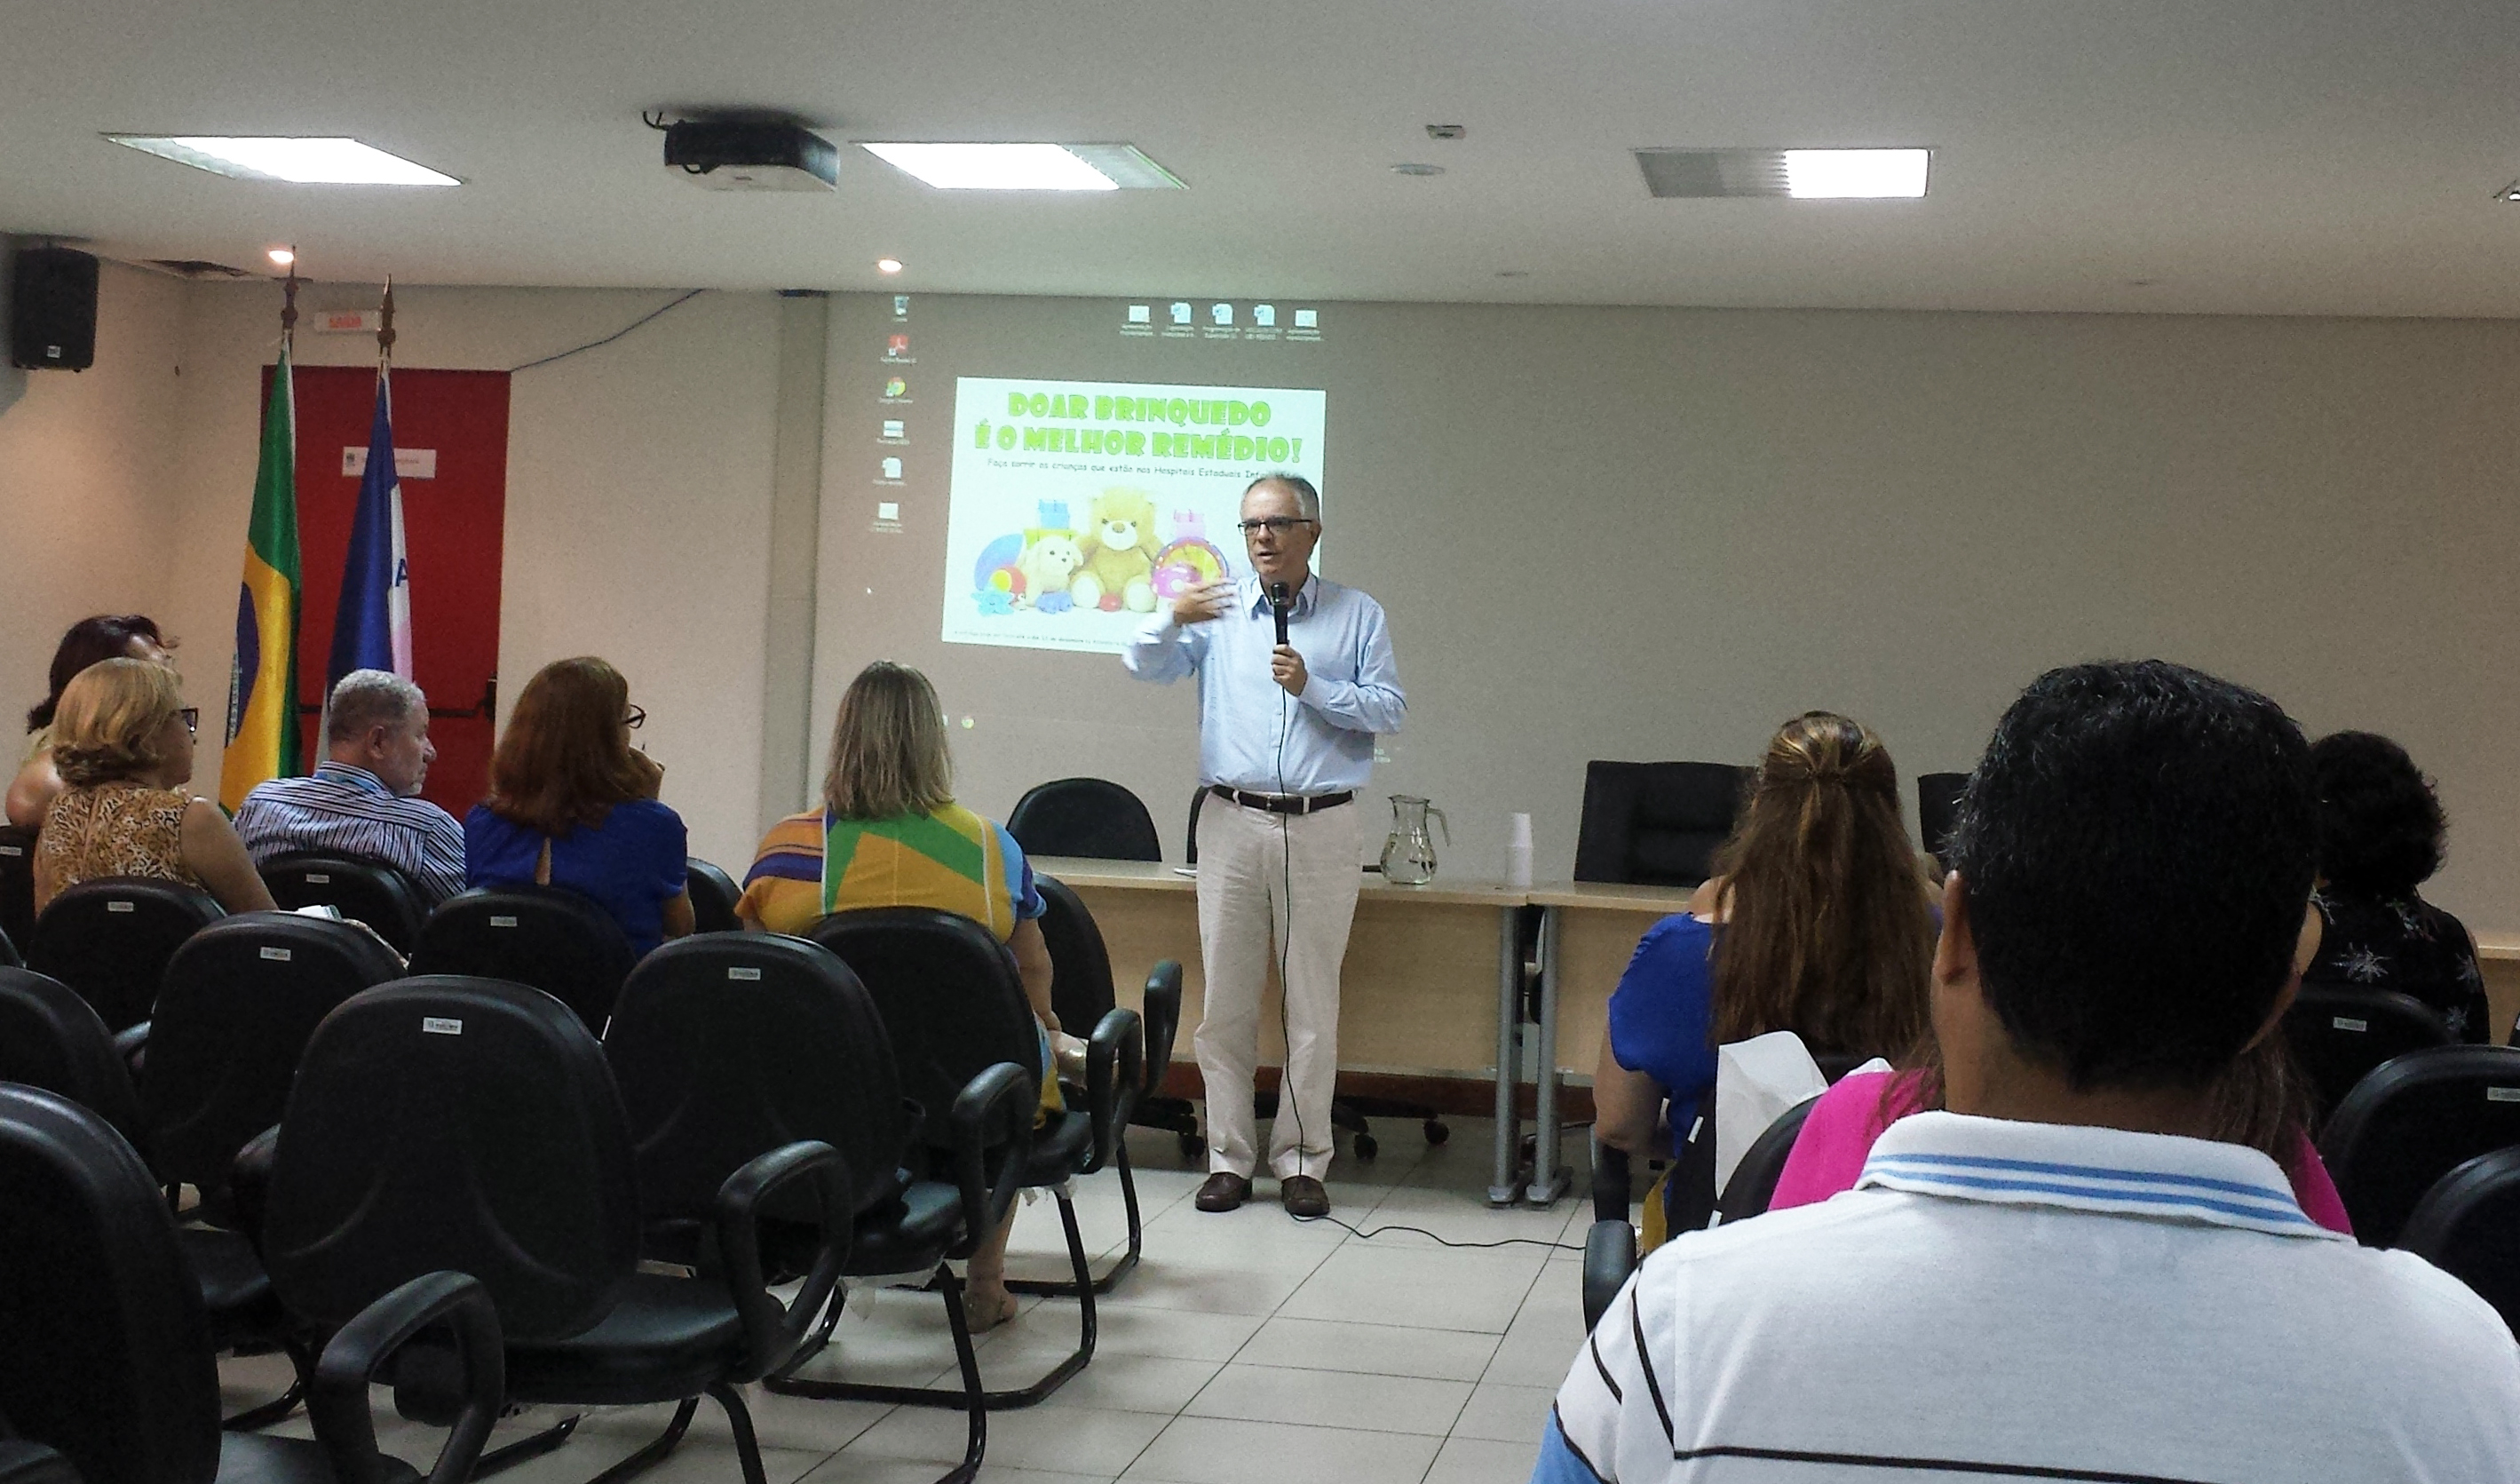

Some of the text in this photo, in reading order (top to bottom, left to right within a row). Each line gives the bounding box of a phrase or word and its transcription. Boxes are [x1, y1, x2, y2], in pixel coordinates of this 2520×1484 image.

[1008, 392, 1272, 427] DOAR BRINQUEDO
[975, 417, 1303, 464] É O MELHOR REMÉDIO!
[1051, 463, 1087, 472] crianças
[1090, 464, 1105, 473] que
[1109, 463, 1133, 472] estão
[1153, 466, 1195, 477] Hospitais
[1198, 467, 1241, 479] Estaduais
